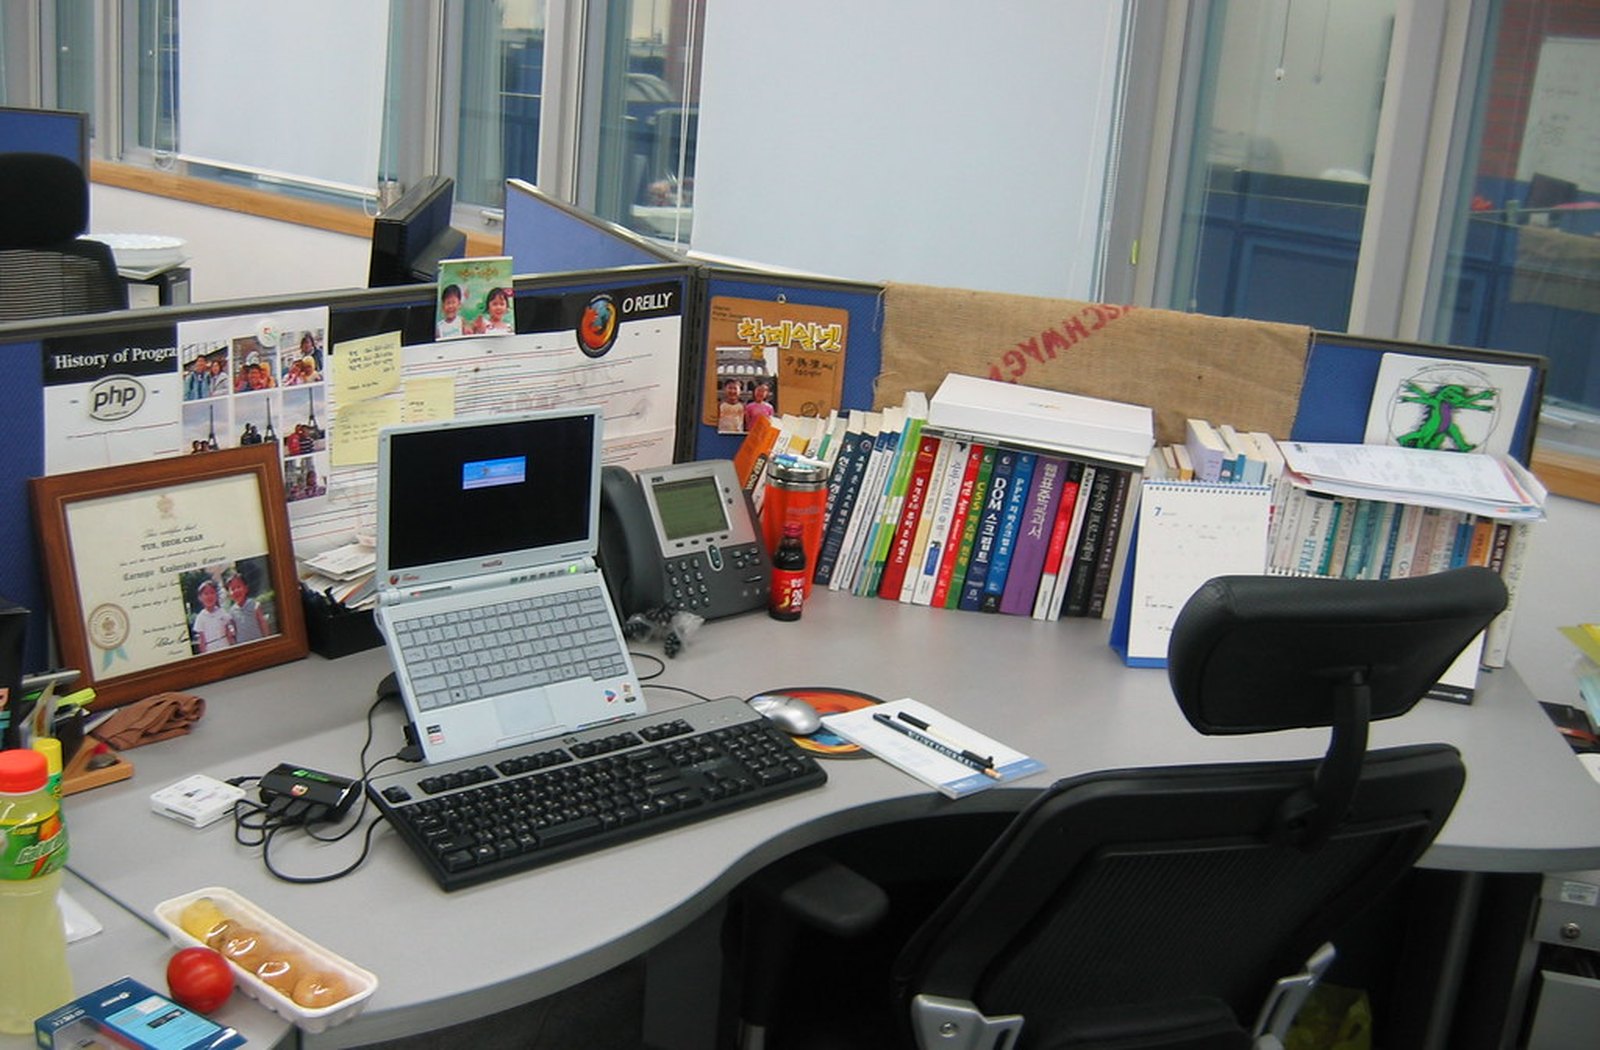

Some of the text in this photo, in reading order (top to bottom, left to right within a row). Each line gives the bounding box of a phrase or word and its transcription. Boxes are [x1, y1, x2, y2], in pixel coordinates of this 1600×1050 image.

[55, 353, 108, 370] History
[113, 346, 129, 363] of
[93, 386, 136, 412] php
[971, 482, 986, 511] CSS
[988, 477, 1007, 511] DOM
